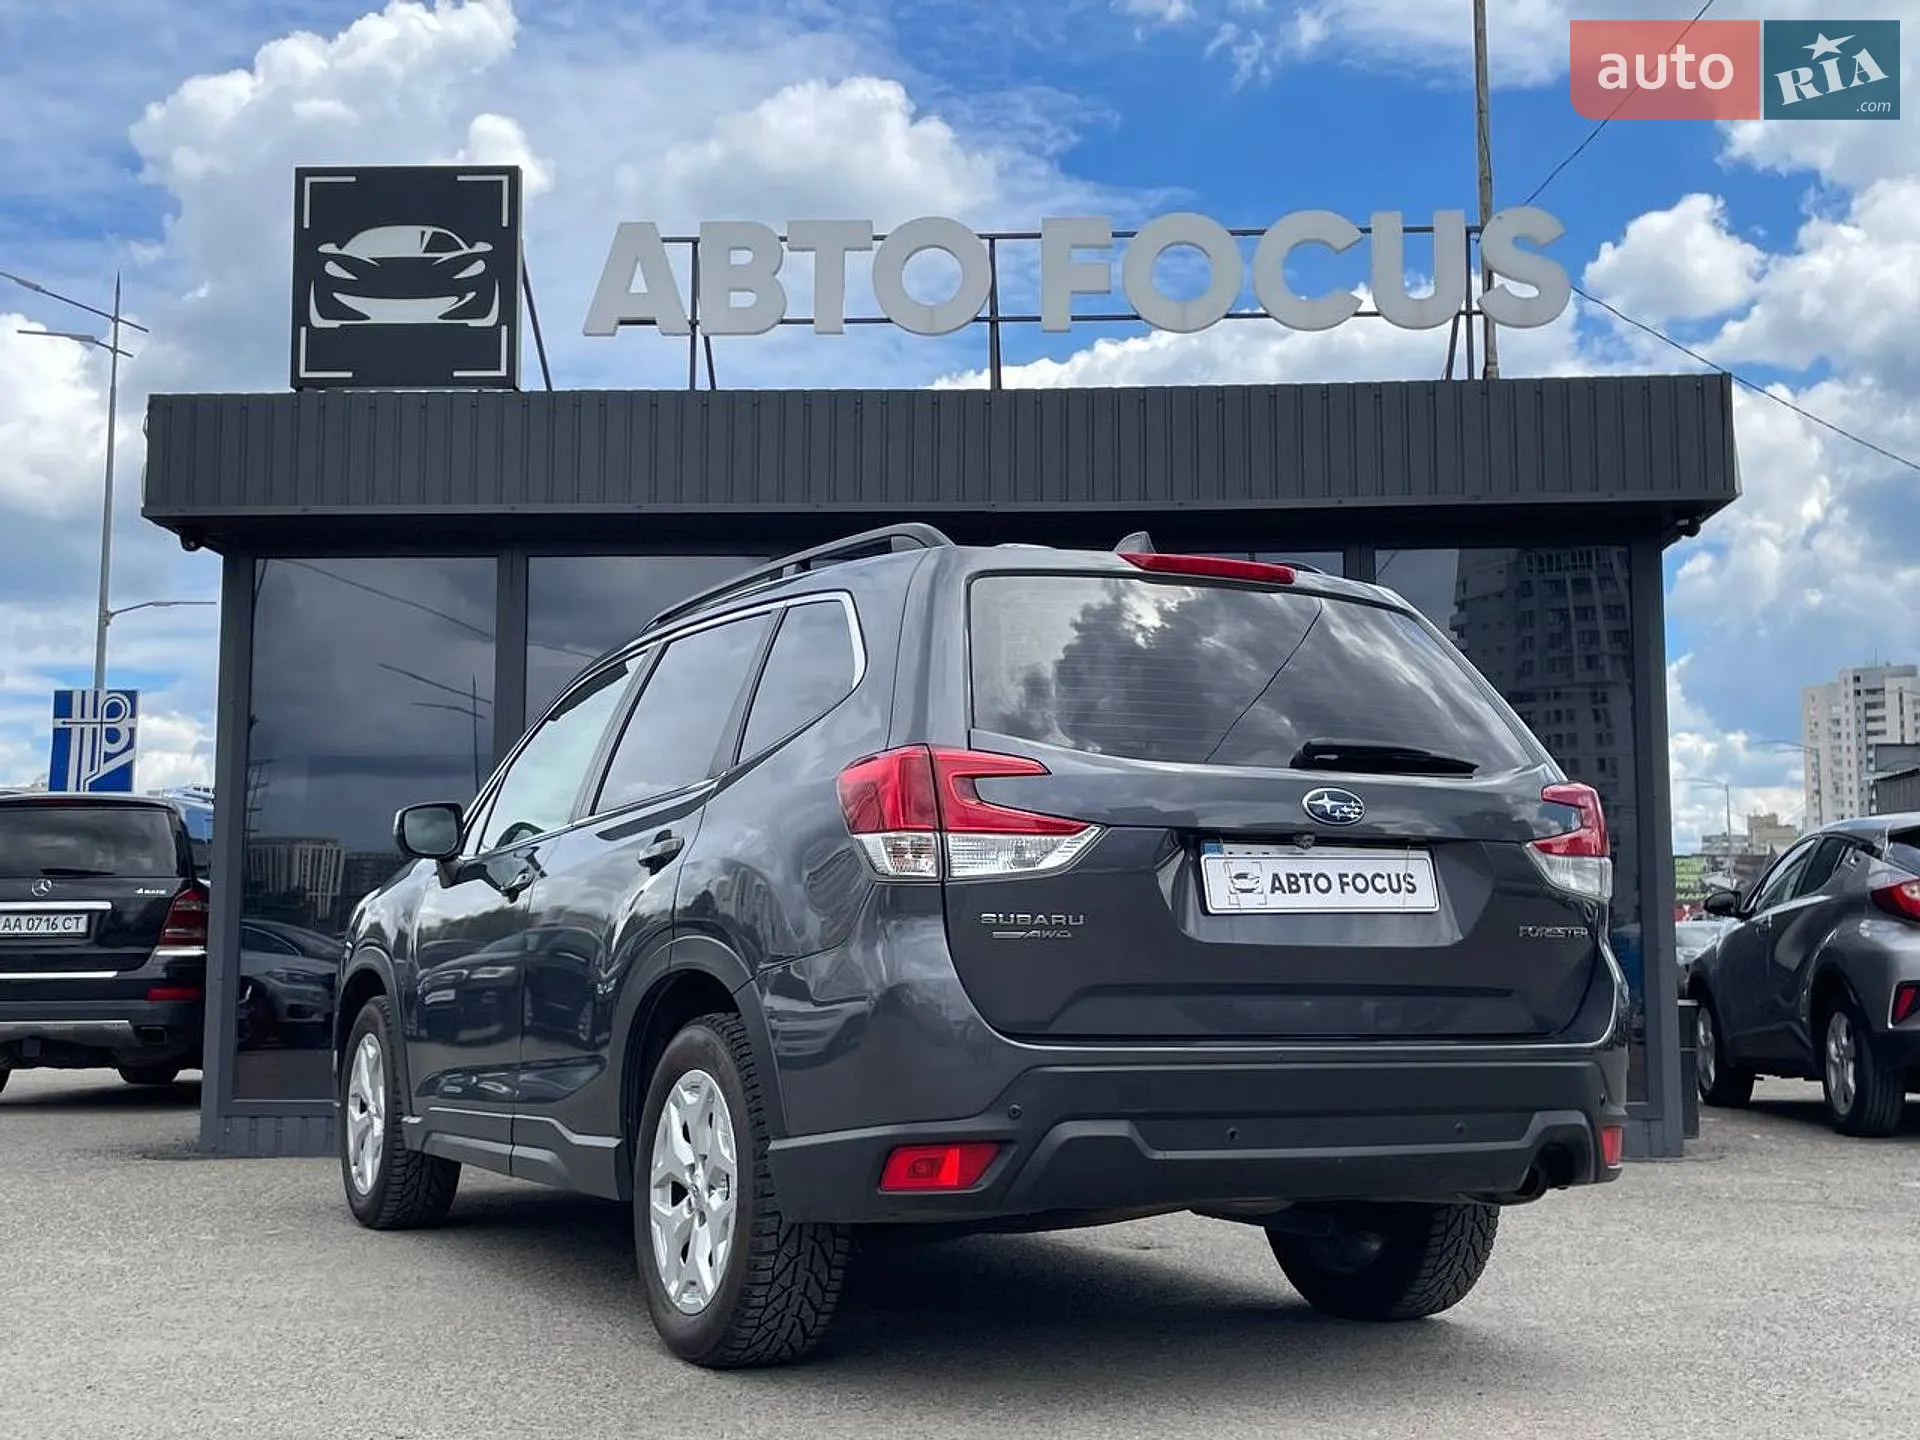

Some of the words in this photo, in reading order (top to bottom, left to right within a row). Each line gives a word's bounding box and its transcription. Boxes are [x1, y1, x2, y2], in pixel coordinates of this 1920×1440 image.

[583, 216, 992, 336] АВТО
[1041, 208, 1572, 334] FOCUS
[1269, 873, 1332, 895] АВТО
[1340, 873, 1418, 895] FOCUS
[2, 917, 22, 931] AA
[26, 917, 58, 931] 0716
[62, 916, 83, 931] CT
[980, 913, 1085, 926] SUBARU
[1021, 929, 1072, 938] AWD
